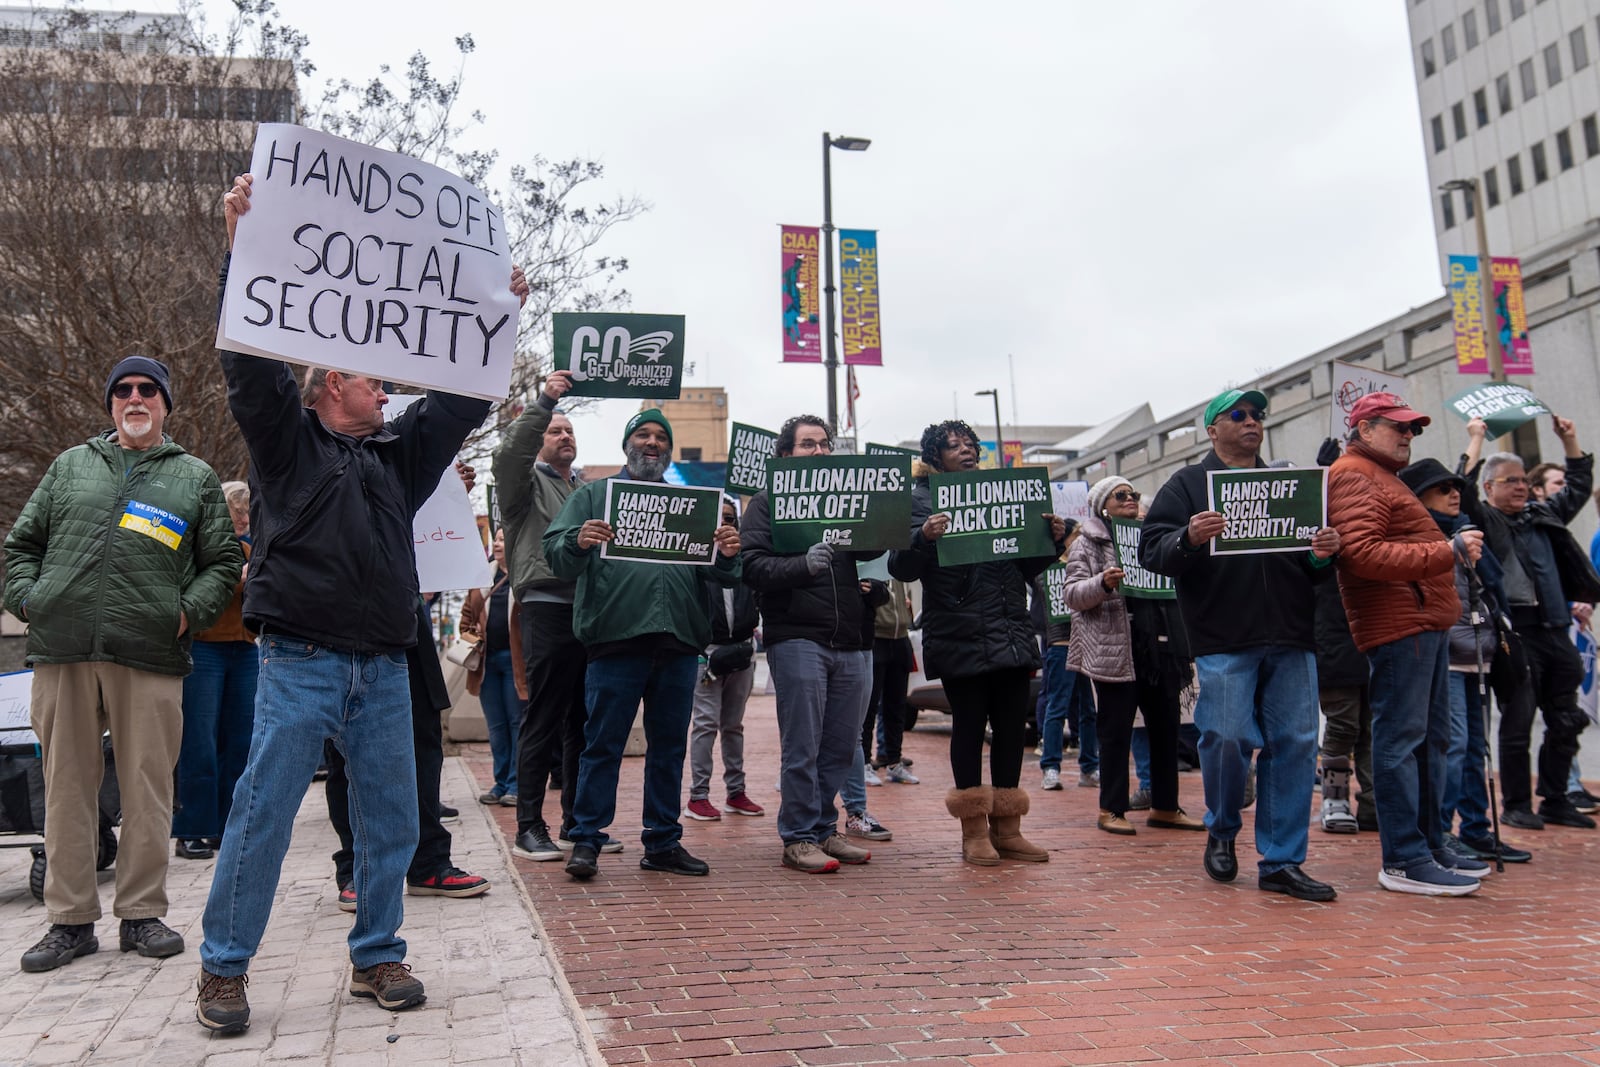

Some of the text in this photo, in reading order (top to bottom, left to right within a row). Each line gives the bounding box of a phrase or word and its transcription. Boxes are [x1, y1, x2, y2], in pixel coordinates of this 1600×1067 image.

[266, 140, 498, 246] HANDS OFF
[783, 232, 818, 249] CIAA
[293, 223, 480, 305] SOCIAL
[841, 238, 862, 355] WELCOME TO
[860, 248, 880, 348] BALTIMORE
[243, 275, 510, 367] SECURITY
[1451, 263, 1473, 366] WELCOME TO
[569, 326, 631, 381] GO
[627, 378, 670, 387] AFSCME
[732, 447, 768, 471] SOCI
[773, 467, 905, 494] BILLIONAIRES:
[1221, 480, 1298, 502] HANDS OFF
[617, 492, 697, 515] HANDS OFF
[938, 479, 1047, 509] BILLIONAIRES:
[135, 502, 184, 526] WE STAND WITH
[775, 494, 869, 520] BACK OFF!
[942, 507, 987, 534] BACK
[991, 504, 1025, 529] OFF!
[1222, 500, 1270, 520] SOCIAL
[125, 519, 176, 545] UKRAINE
[616, 510, 666, 531] SOCIAL
[1221, 517, 1295, 539] SECURITY!
[614, 528, 689, 550] SECURITY!
[1116, 524, 1141, 547] HAND
[1119, 545, 1141, 567] SOCI
[1123, 565, 1175, 589] SECURITY
